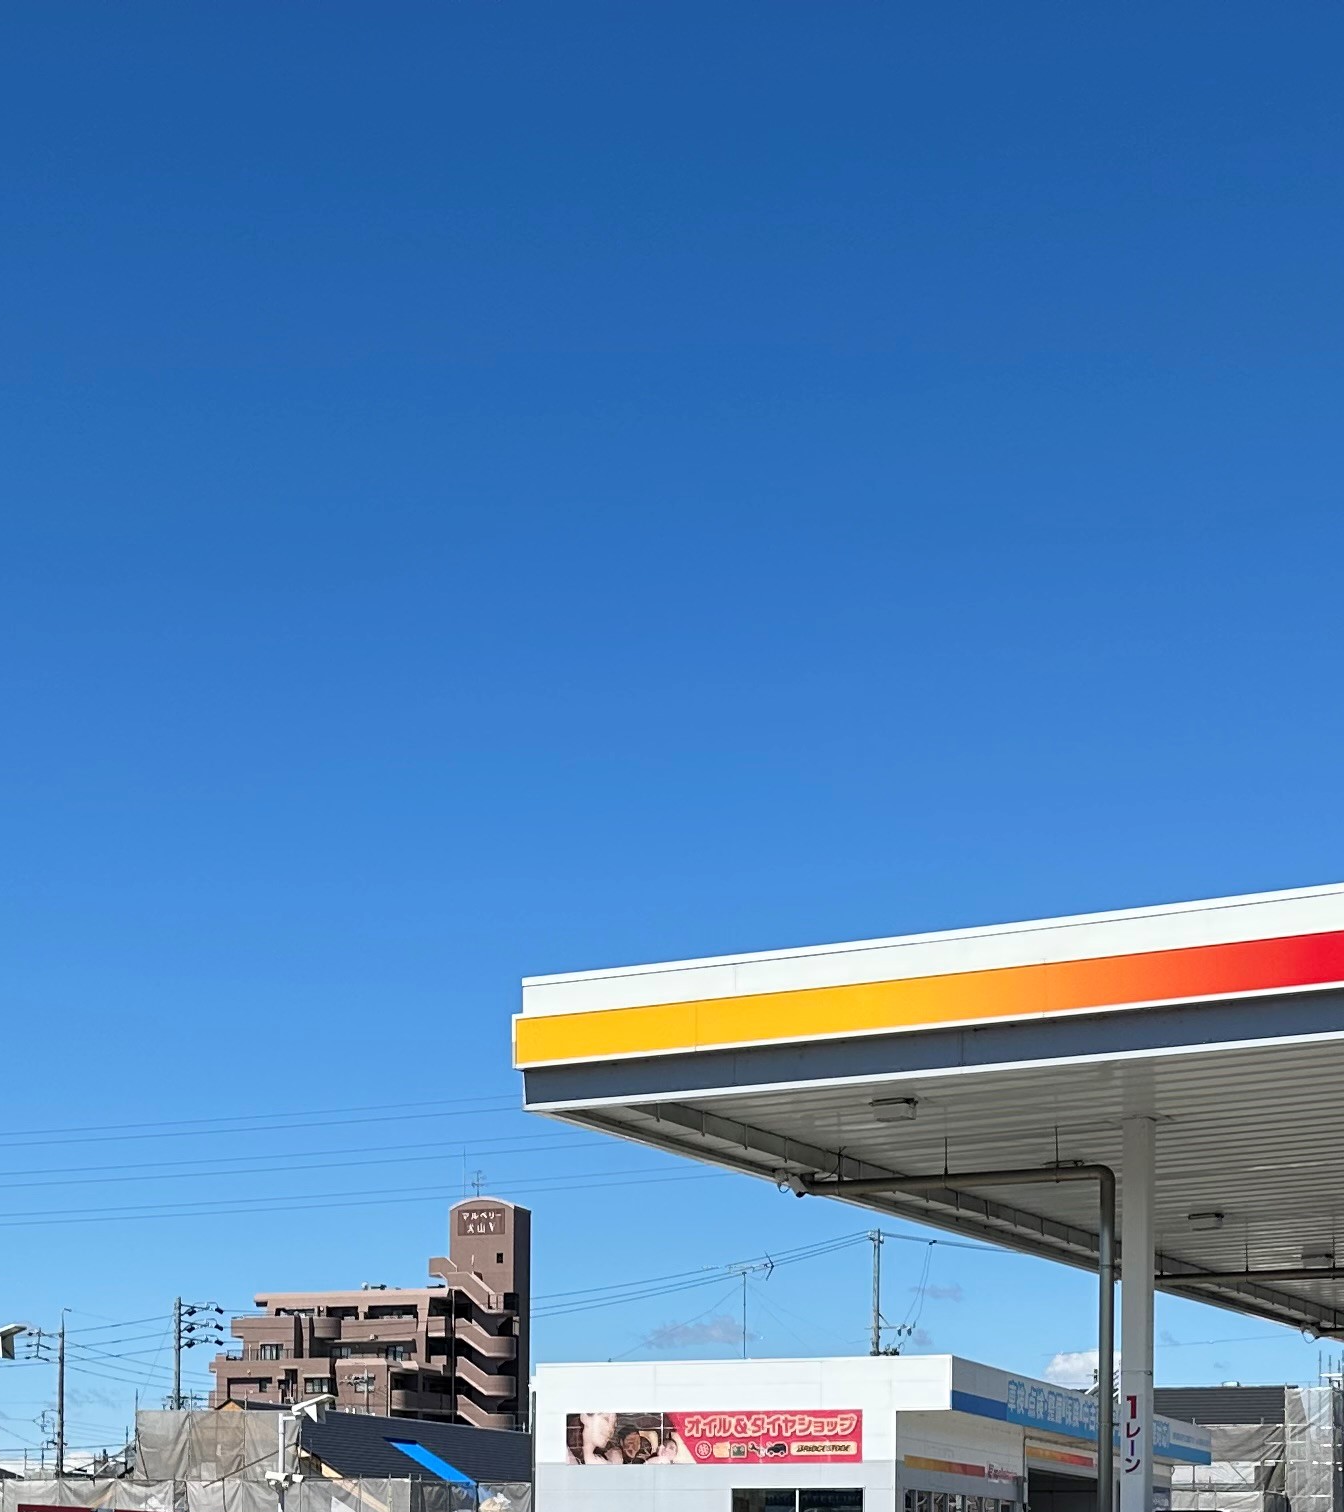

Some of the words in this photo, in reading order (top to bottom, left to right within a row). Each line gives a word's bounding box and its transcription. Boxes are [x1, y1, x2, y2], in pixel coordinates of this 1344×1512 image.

[684, 1415, 857, 1438] オイル&タイヤショップ
[1124, 1395, 1142, 1473] 1レーン
